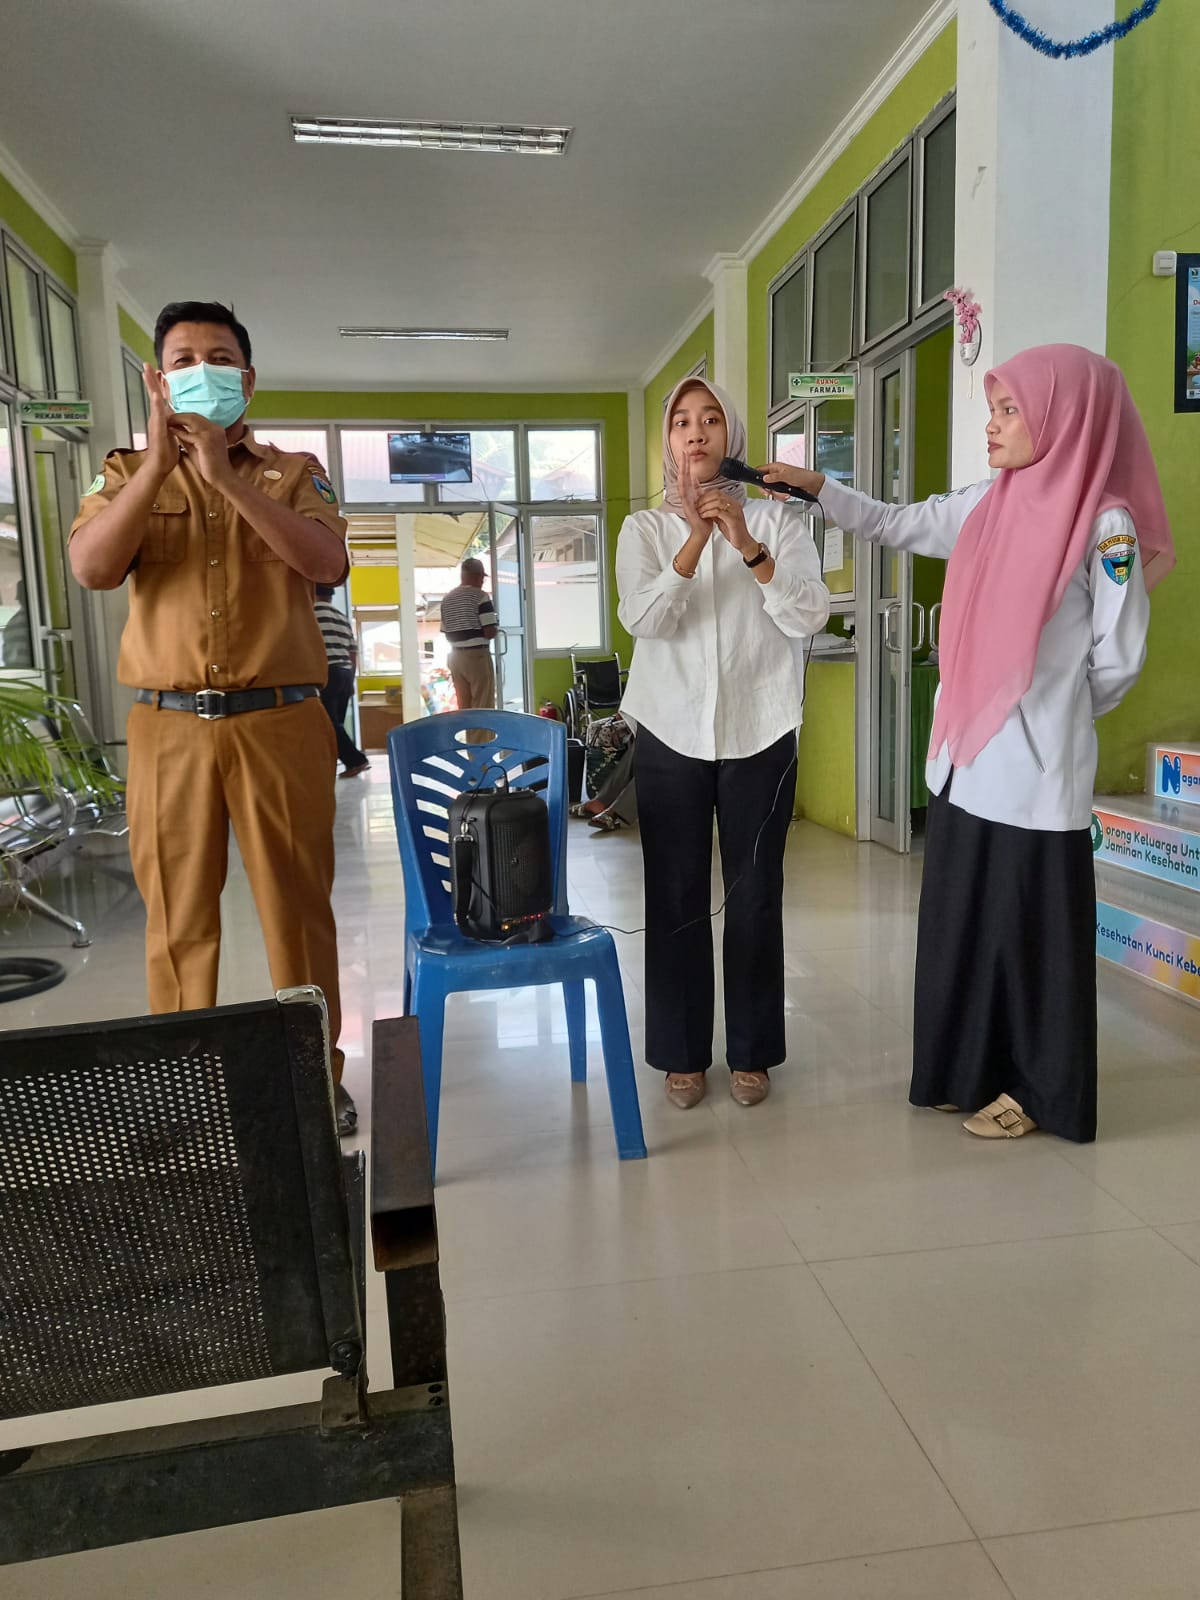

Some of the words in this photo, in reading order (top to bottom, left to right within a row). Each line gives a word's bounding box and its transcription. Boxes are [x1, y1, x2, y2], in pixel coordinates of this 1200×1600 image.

[34, 412, 62, 420] REKAM
[1105, 839, 1143, 860] Jaminan
[1145, 850, 1199, 877] Kesehatan
[1134, 830, 1178, 856] Keluarga
[1096, 921, 1144, 953] Kesehatan
[1146, 942, 1174, 966] Kunci
